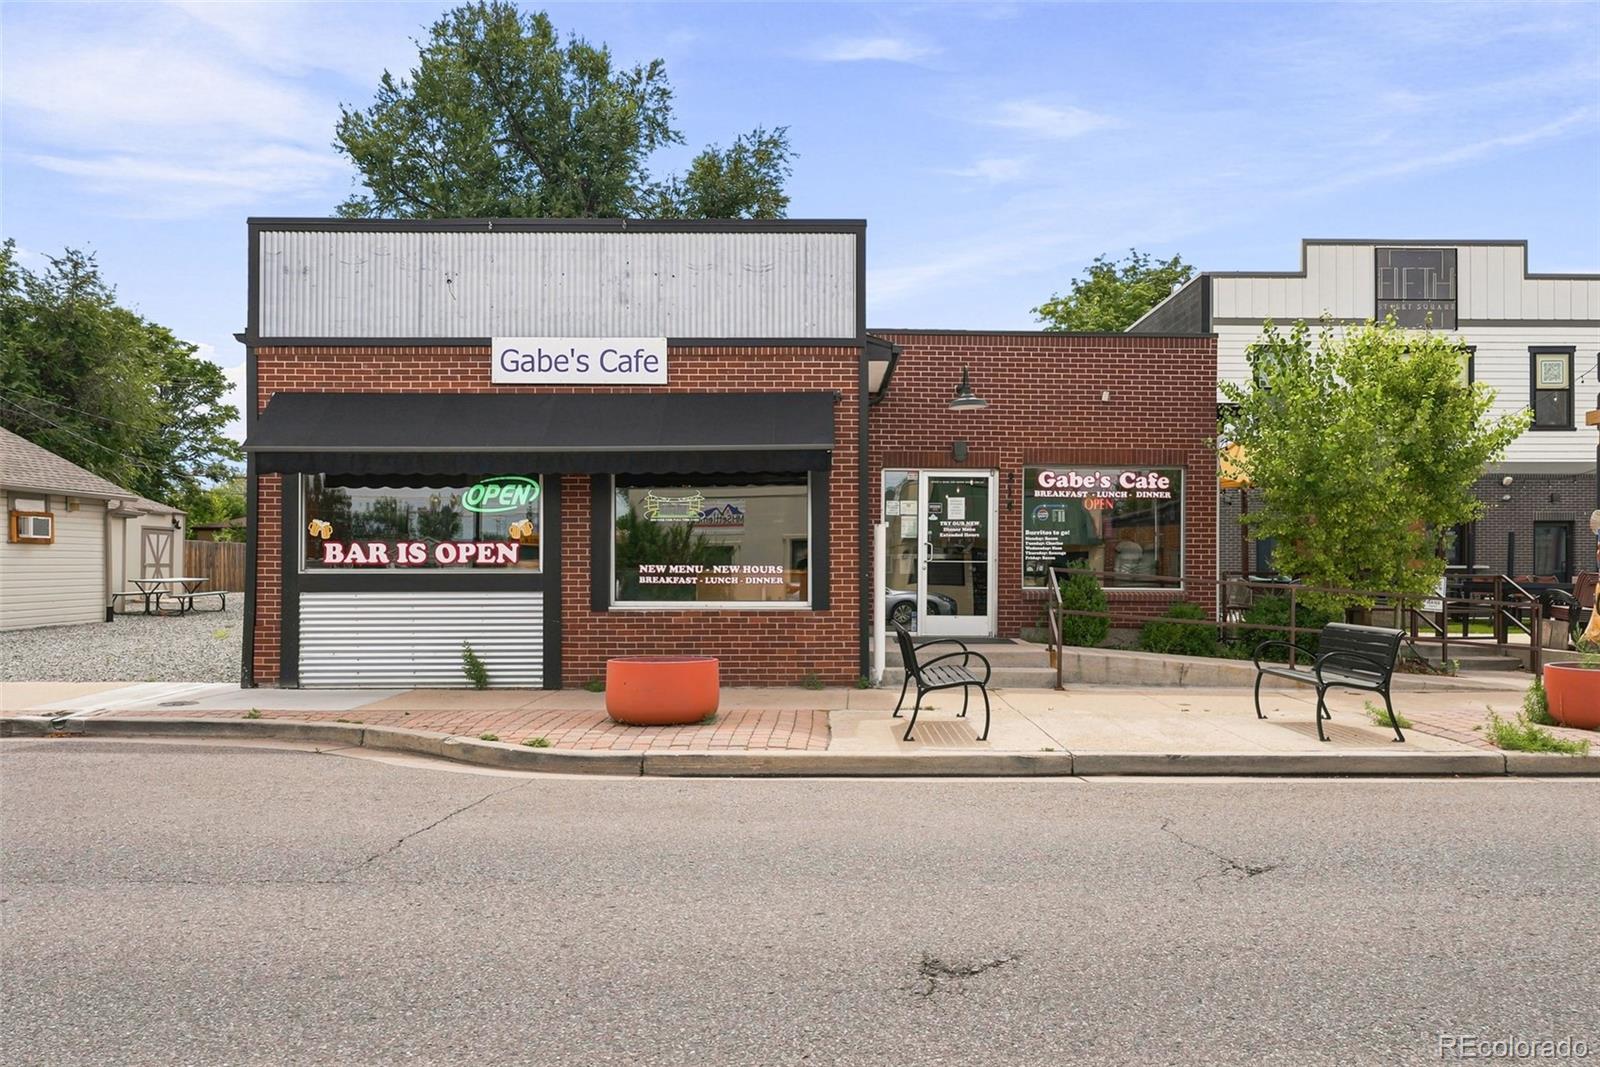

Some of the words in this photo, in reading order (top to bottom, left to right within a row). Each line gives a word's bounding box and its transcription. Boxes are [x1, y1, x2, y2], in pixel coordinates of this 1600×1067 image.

[500, 348, 589, 373] Gabe's
[600, 348, 659, 373] Cafe
[1037, 470, 1111, 488] Gabe's
[1119, 471, 1170, 489] Cafe
[466, 483, 531, 505] OPEN
[1034, 490, 1087, 498] BREAKFAST
[1097, 490, 1127, 498] LUNCH
[1083, 499, 1114, 510] OPEN
[323, 542, 390, 564] BAR
[396, 542, 427, 564] IS
[435, 542, 519, 564] OPEN
[639, 565, 667, 574] NEW
[669, 565, 704, 574] MENU
[713, 565, 740, 574] NEW
[742, 565, 784, 574] HOURS
[639, 576, 697, 584] BREAKFAST
[705, 576, 738, 584] LUNCH
[745, 576, 784, 584] DINNER
